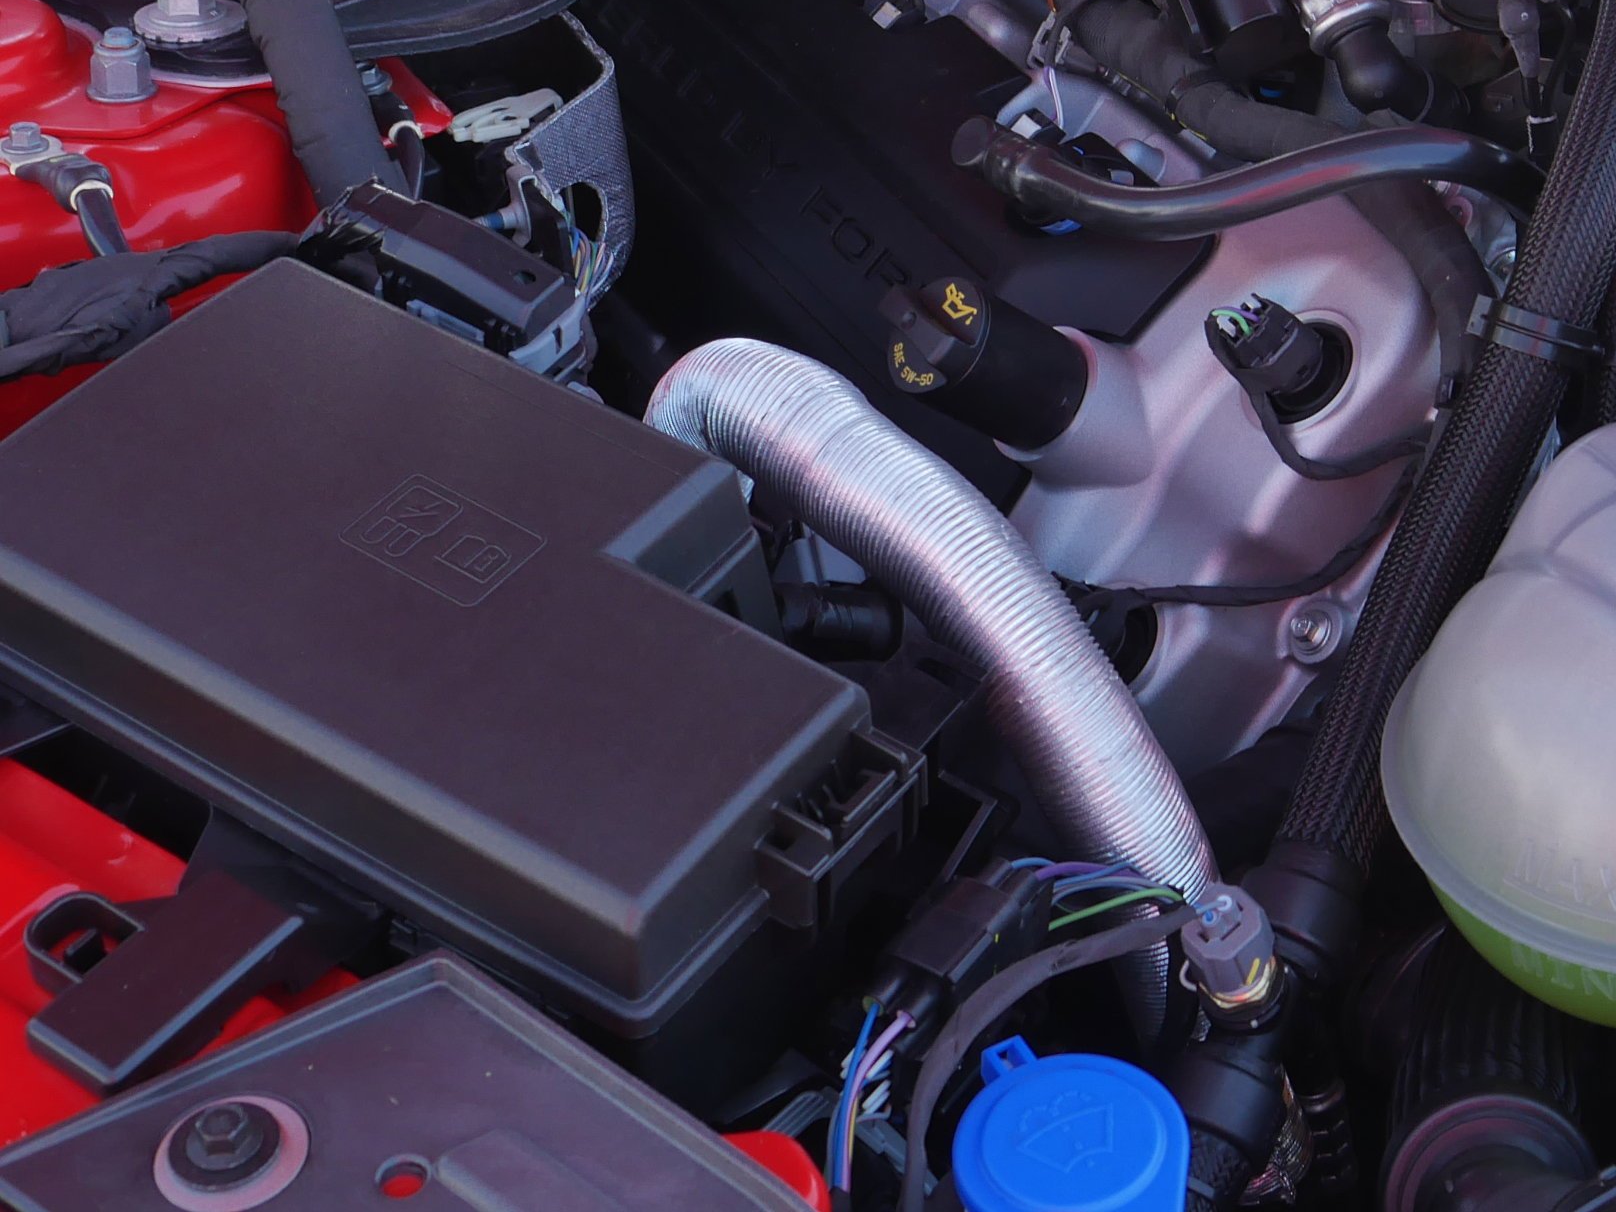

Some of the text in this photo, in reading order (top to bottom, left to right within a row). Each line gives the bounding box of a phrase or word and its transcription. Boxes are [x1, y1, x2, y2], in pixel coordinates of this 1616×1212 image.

[800, 184, 920, 288] FOR
[893, 342, 934, 386] SAE 5W-50
